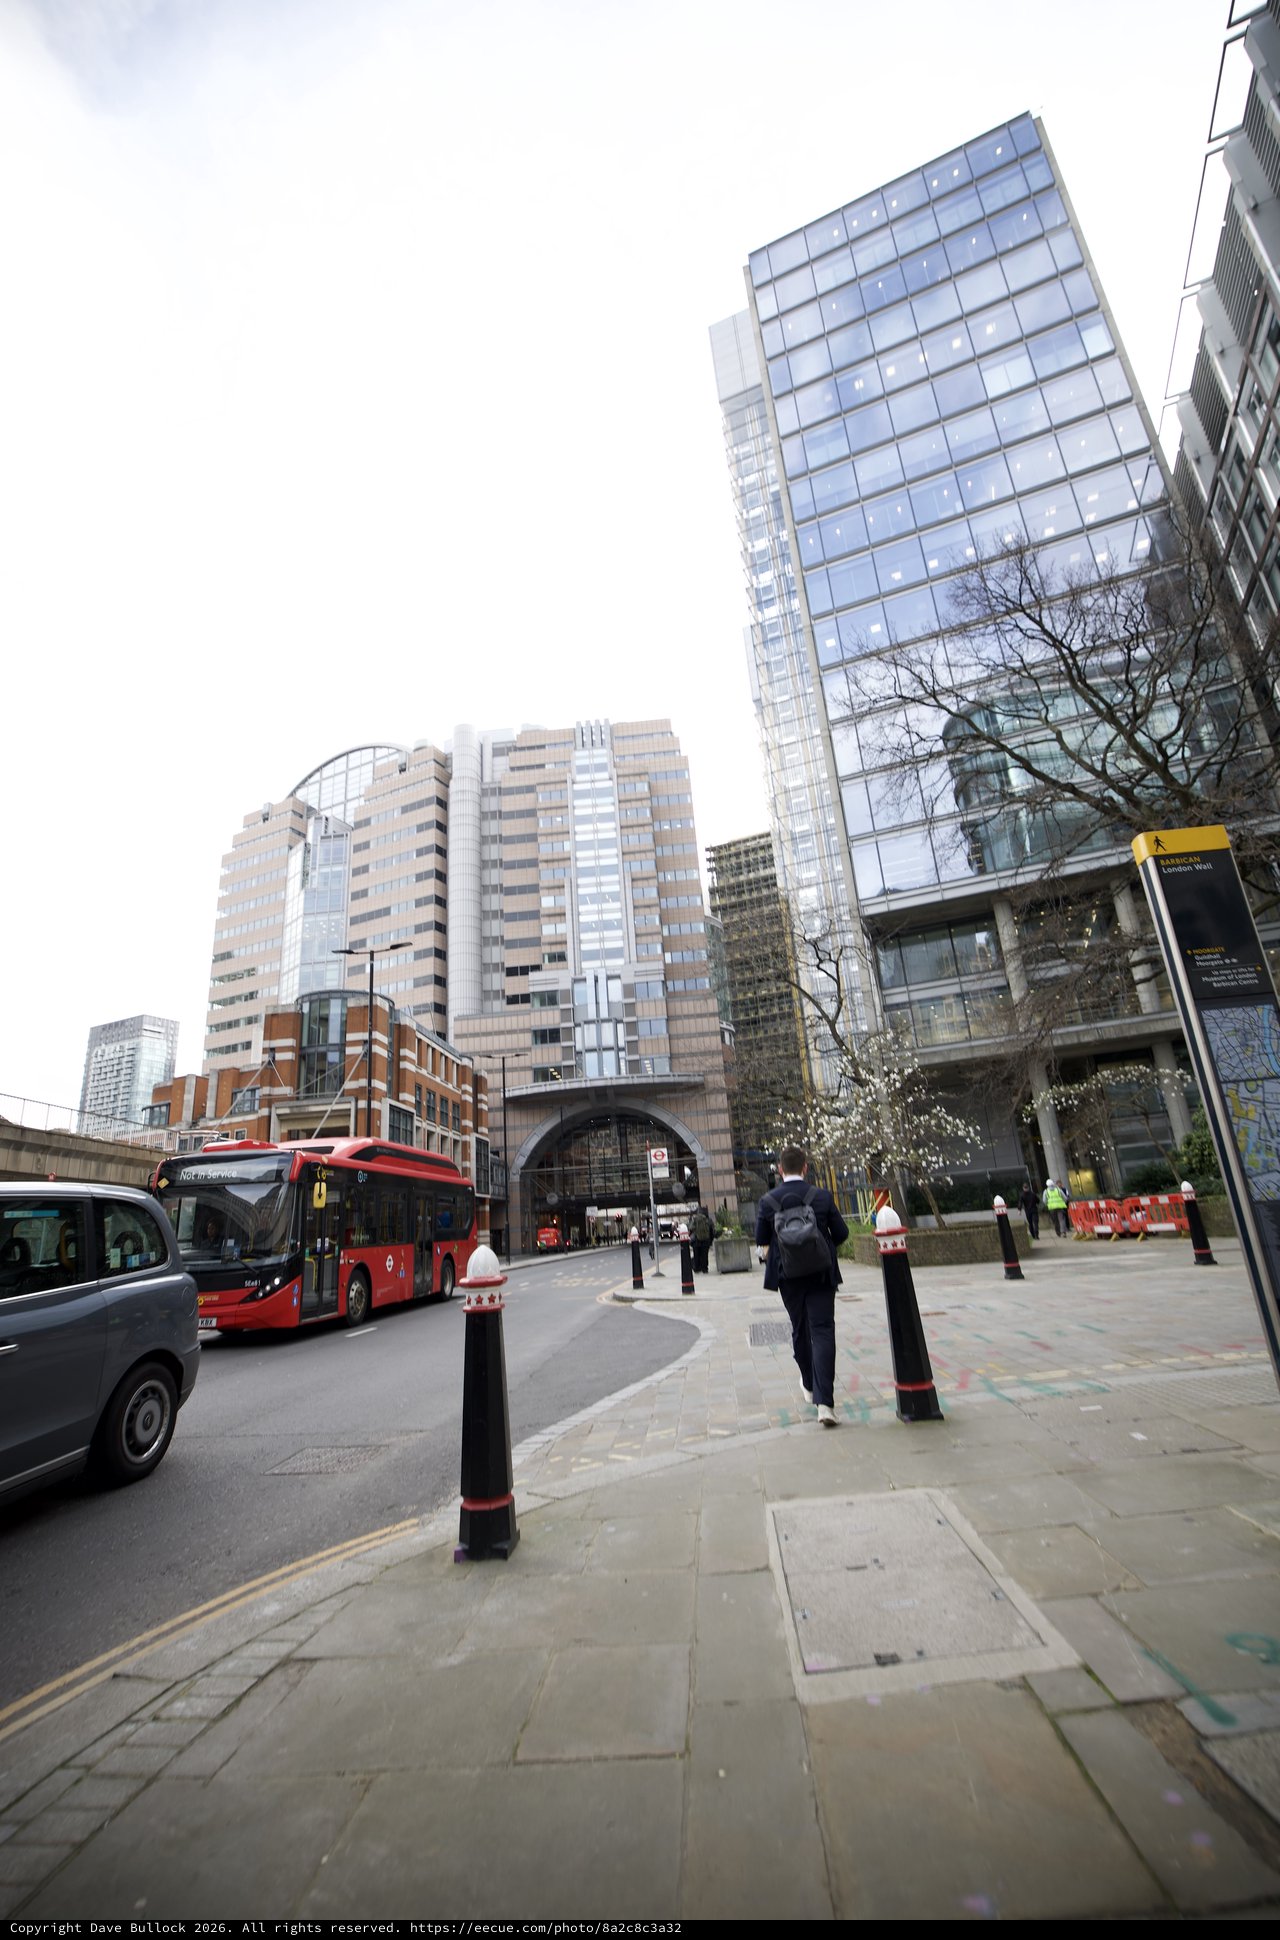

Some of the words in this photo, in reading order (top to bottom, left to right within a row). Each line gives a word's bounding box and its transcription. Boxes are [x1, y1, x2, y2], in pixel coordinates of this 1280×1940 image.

[1160, 856, 1201, 865] BARBICAN
[1162, 865, 1193, 873] London
[1193, 862, 1213, 870] Wall
[180, 1170, 195, 1180] Not
[207, 1169, 238, 1179] Service
